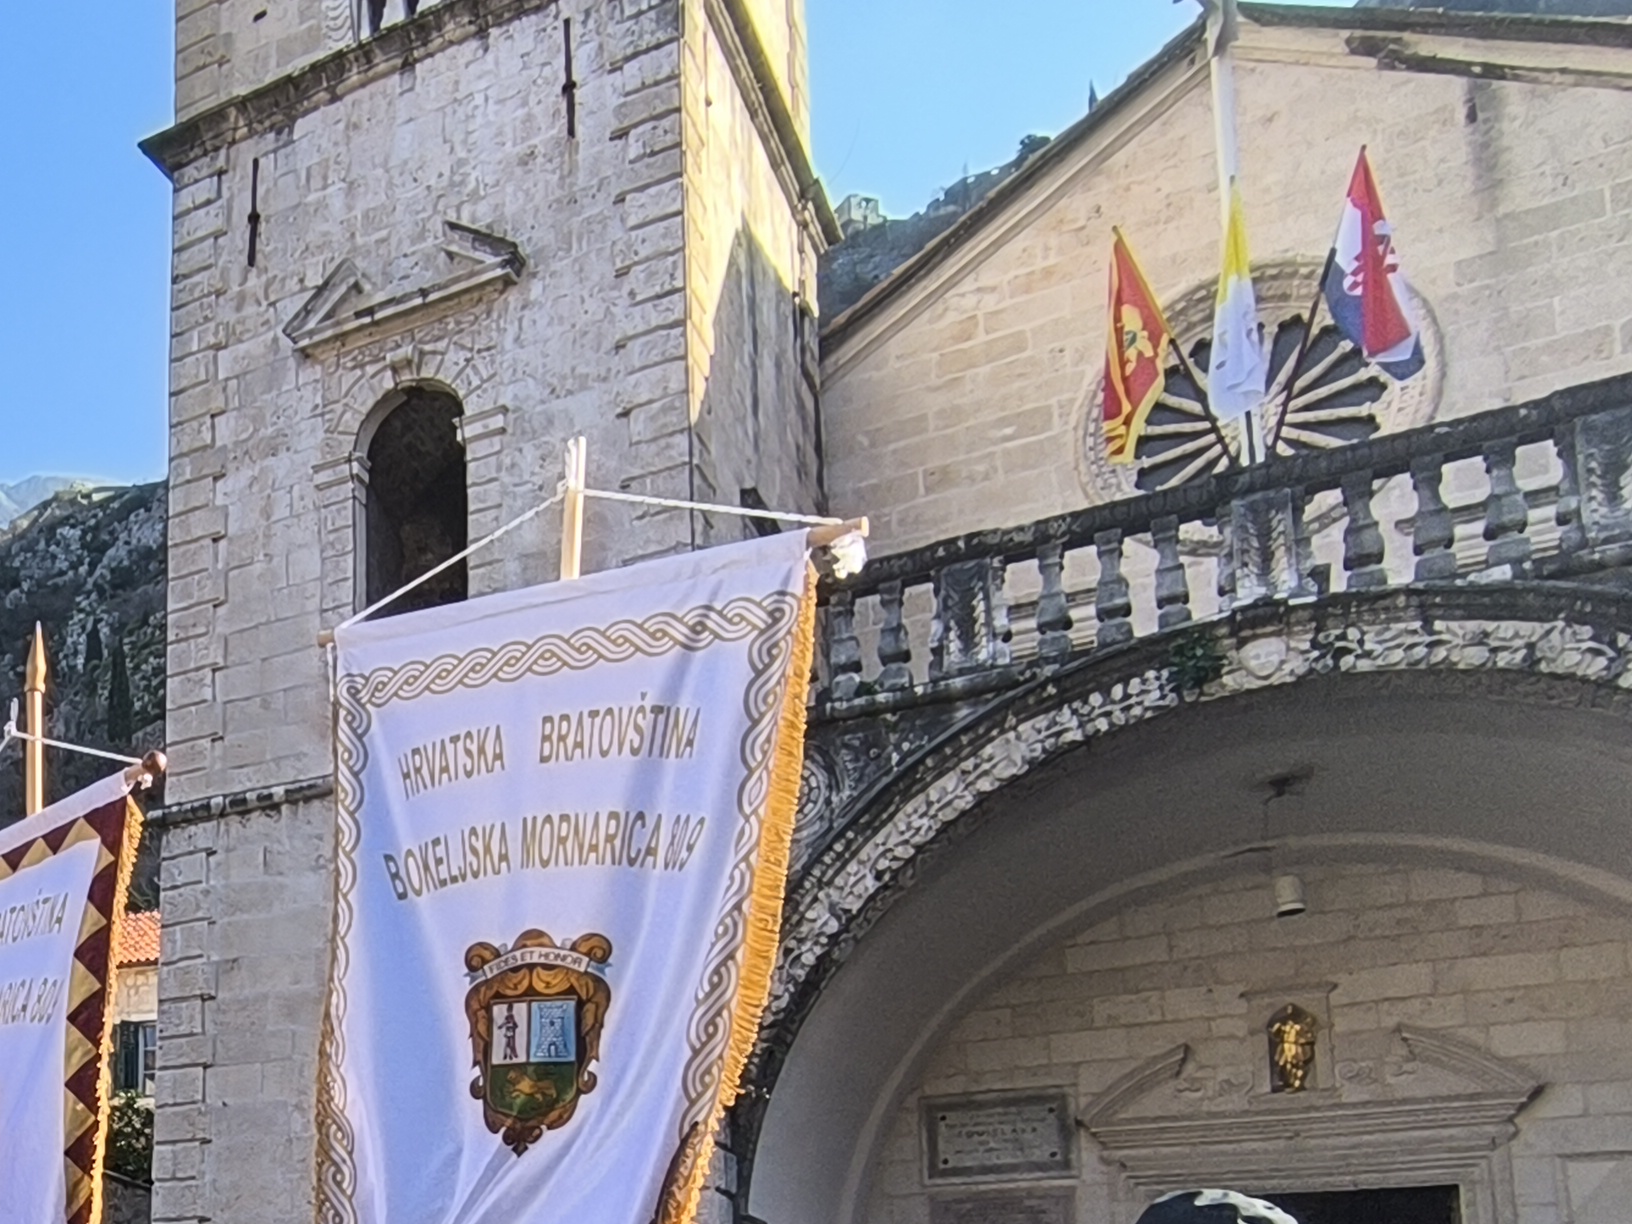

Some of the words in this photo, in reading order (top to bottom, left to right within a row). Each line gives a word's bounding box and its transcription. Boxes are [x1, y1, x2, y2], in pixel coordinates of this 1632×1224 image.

[397, 724, 506, 800] HRVATSKA
[538, 691, 701, 764] BRATOVŠTINA
[382, 821, 511, 901] BOKELJSKA
[520, 810, 663, 870] MORNARICA
[488, 952, 518, 975] FIDES
[520, 951, 534, 962] ET
[538, 950, 584, 969] HONOR
